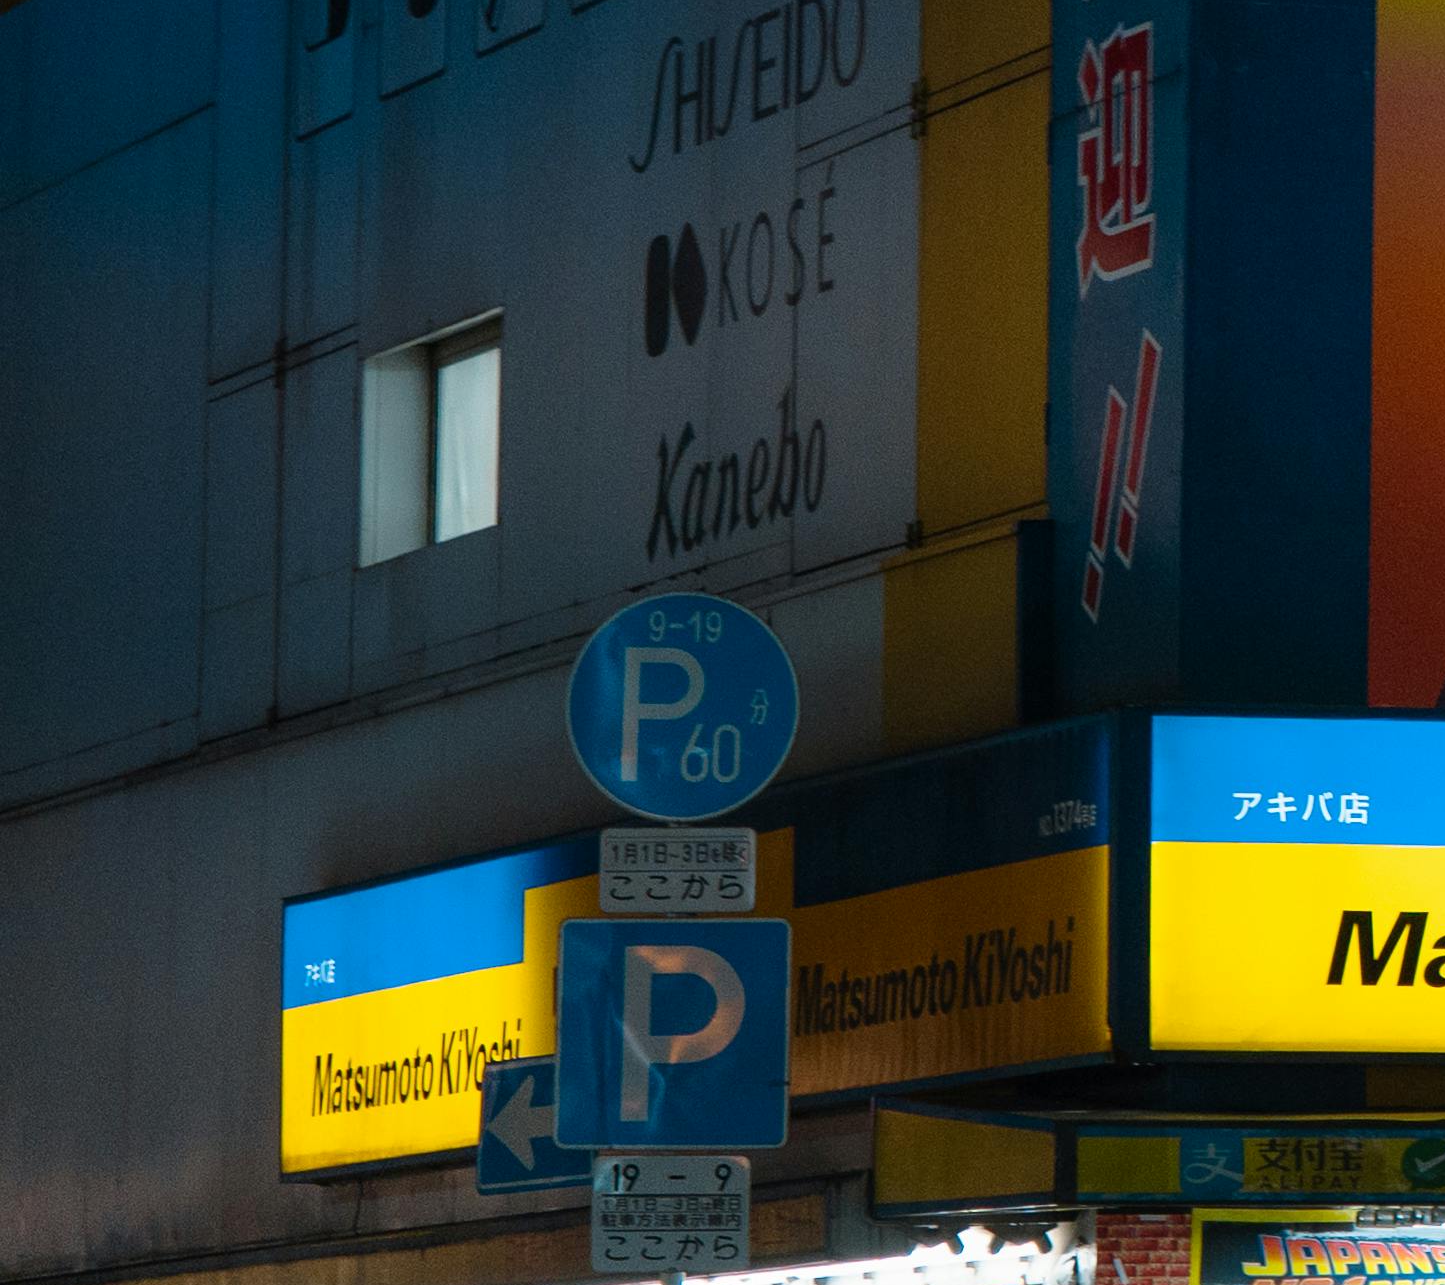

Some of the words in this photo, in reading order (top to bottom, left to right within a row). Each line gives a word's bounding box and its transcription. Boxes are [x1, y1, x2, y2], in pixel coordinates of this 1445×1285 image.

[719, 162, 839, 328] KOSÉ
[645, 396, 828, 563] Kanebo
[649, 611, 722, 643] 9-19
[621, 647, 706, 782] P
[680, 725, 742, 784] 60
[1231, 791, 1370, 826] アキバ店
[610, 874, 745, 901] ここから
[800, 951, 956, 1037] Matsumoto
[963, 915, 1074, 1012] KiYoshi
[619, 946, 745, 1122] P
[312, 1045, 434, 1117] Matsumoto
[613, 1163, 641, 1192] 19
[714, 1163, 732, 1191] 9
[1258, 1139, 1364, 1172] 支付宝
[605, 1235, 739, 1261] ここから
